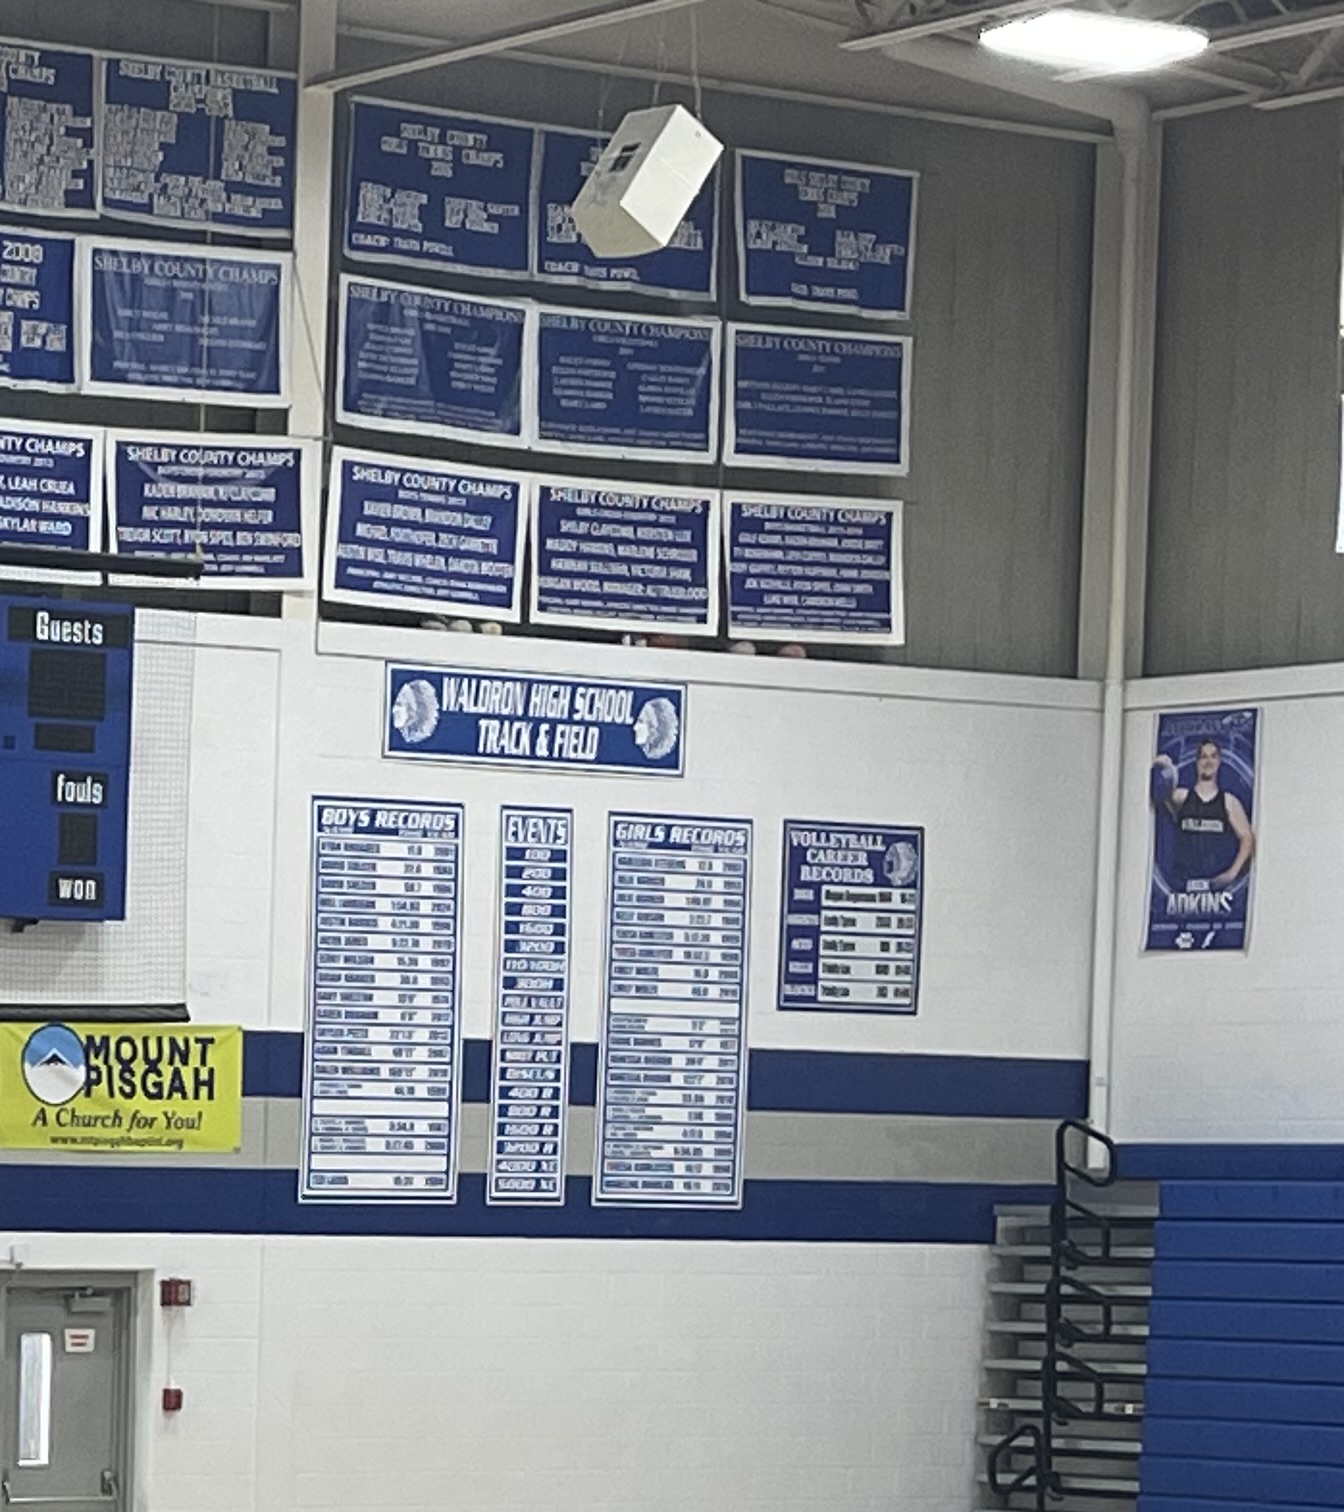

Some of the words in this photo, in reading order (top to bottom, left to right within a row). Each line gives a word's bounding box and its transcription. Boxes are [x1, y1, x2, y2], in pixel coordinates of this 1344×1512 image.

[25, 437, 86, 457] CHAMPS
[126, 446, 177, 463] SHELBY
[179, 448, 235, 466] COUNTY
[237, 451, 294, 467] CHAMPS
[402, 472, 457, 493] COUNTY
[35, 610, 105, 646] Guests
[441, 677, 528, 716] WALDRON
[528, 683, 572, 718] HIGH
[573, 687, 635, 725] SCHOOL
[477, 719, 533, 755] TRACK
[535, 724, 551, 758] &
[553, 725, 599, 761] FIELD
[56, 773, 105, 805] fouls
[321, 808, 371, 827] BOYS
[375, 809, 456, 831] RECORDS
[508, 816, 567, 845] EVENTS
[616, 822, 665, 842] GIRLS
[670, 824, 746, 846] RECORDS
[791, 831, 886, 851] VOLLEYBALL
[806, 849, 869, 865] CAREER
[800, 865, 874, 884] RECORDS
[57, 876, 97, 901] won
[85, 1035, 215, 1067] MOUNT
[84, 1065, 215, 1101] PISGAH
[31, 1107, 48, 1127] A
[56, 1107, 122, 1130] Church
[127, 1109, 158, 1133] for
[162, 1111, 203, 1130] You!
